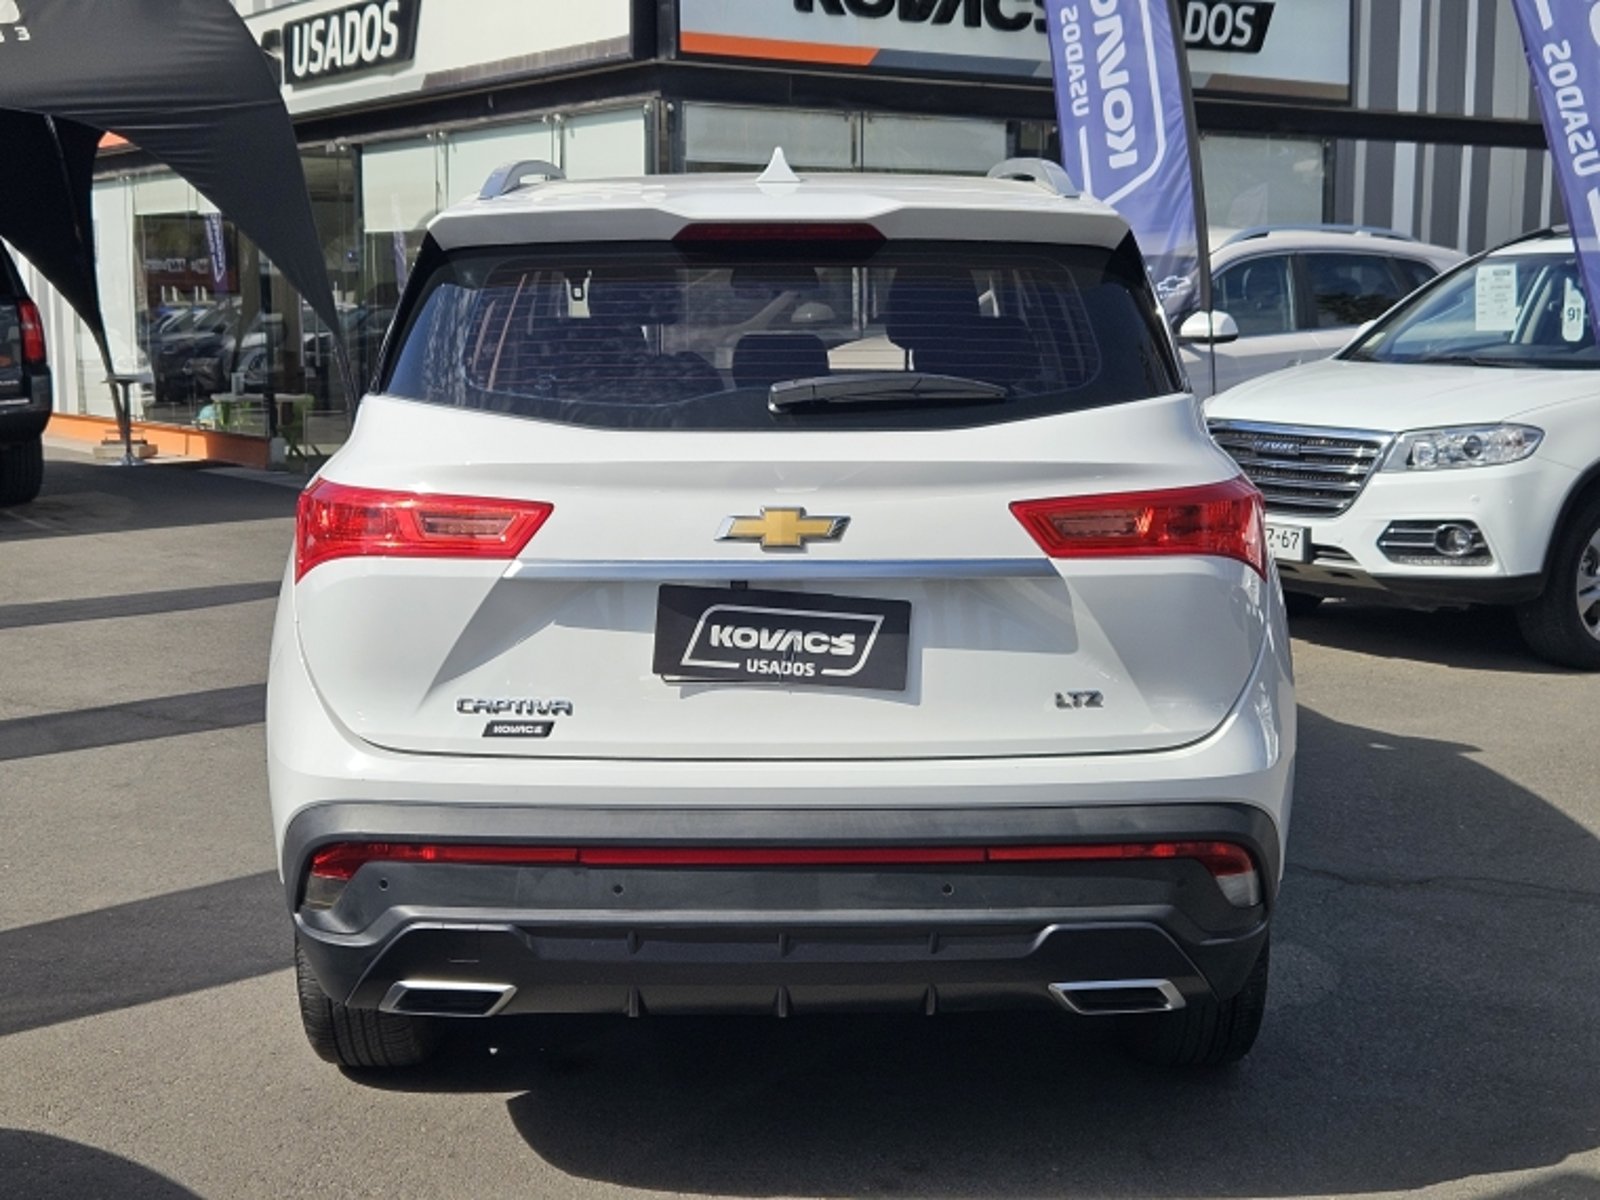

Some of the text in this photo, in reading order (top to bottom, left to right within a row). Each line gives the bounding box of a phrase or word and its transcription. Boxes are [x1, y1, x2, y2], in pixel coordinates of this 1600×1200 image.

[1185, 2, 1255, 46] DOS
[292, 0, 399, 77] USADOS
[711, 625, 855, 655] KOVACS
[746, 659, 815, 677] USADOS
[456, 698, 573, 716] CAPTIVA
[1055, 690, 1104, 708] LTZ
